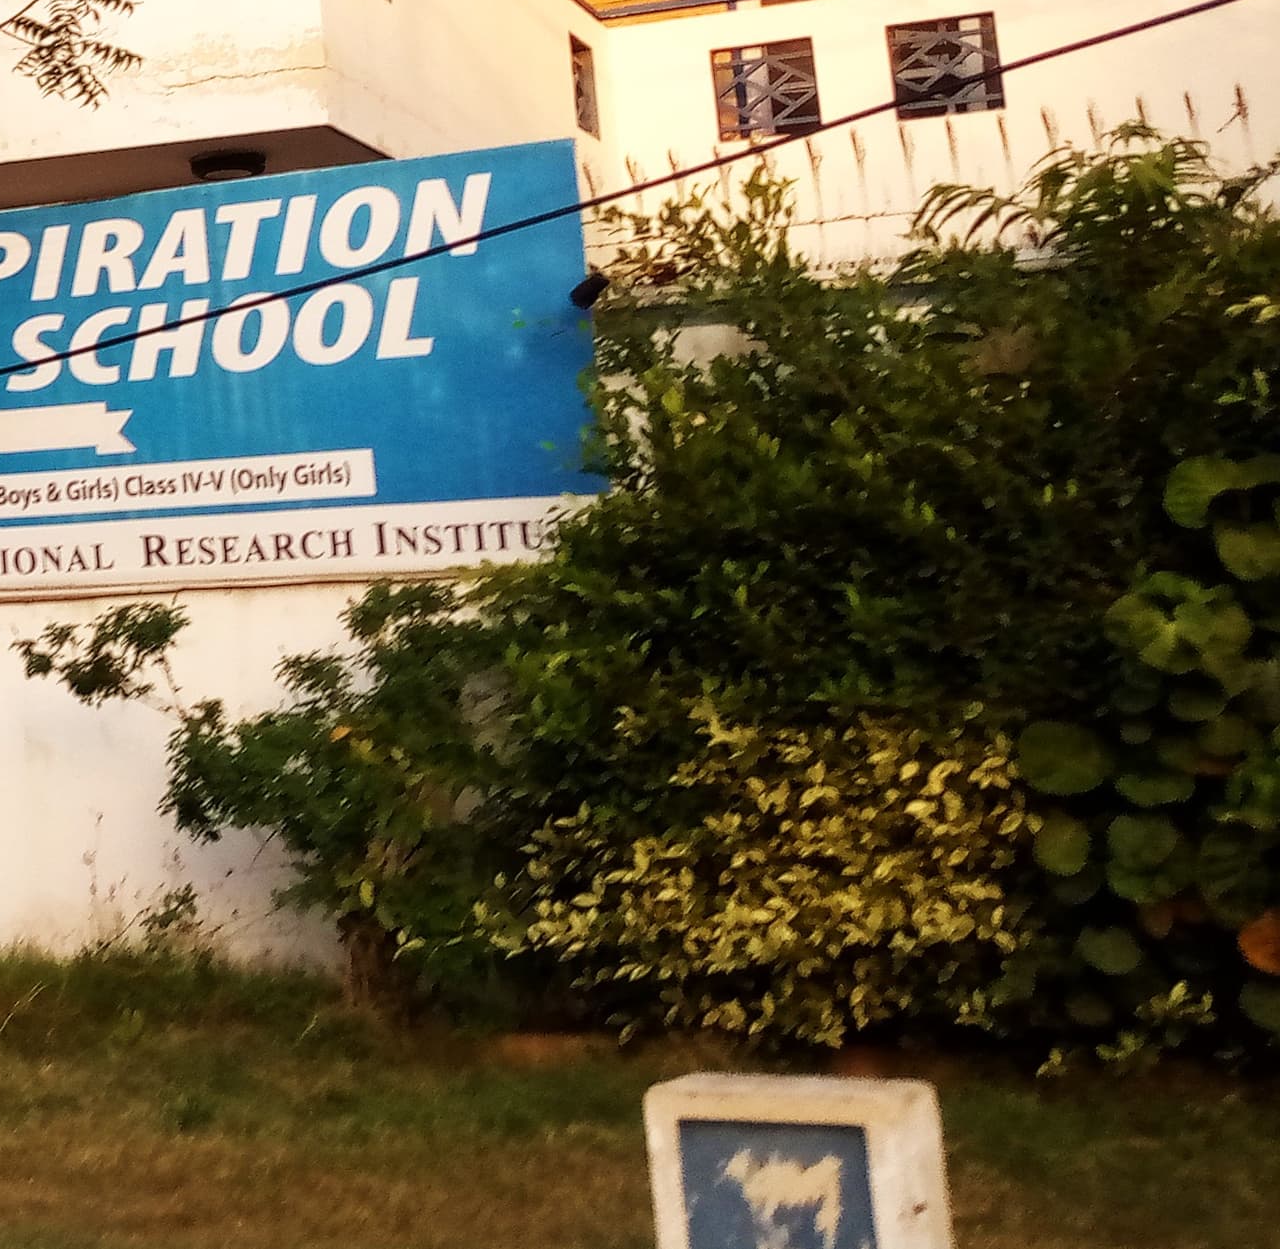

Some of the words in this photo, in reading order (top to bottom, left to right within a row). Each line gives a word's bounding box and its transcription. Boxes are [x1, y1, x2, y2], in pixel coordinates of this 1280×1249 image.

[6, 276, 435, 392] SCHOOL
[45, 481, 61, 502] &
[66, 473, 120, 503] Girls)
[124, 468, 177, 496] Class
[181, 468, 226, 495] IV-V
[229, 464, 287, 495] (Only
[294, 459, 352, 488] Girls)
[139, 524, 355, 569] RESEARCH
[373, 517, 545, 559] INSTITU
